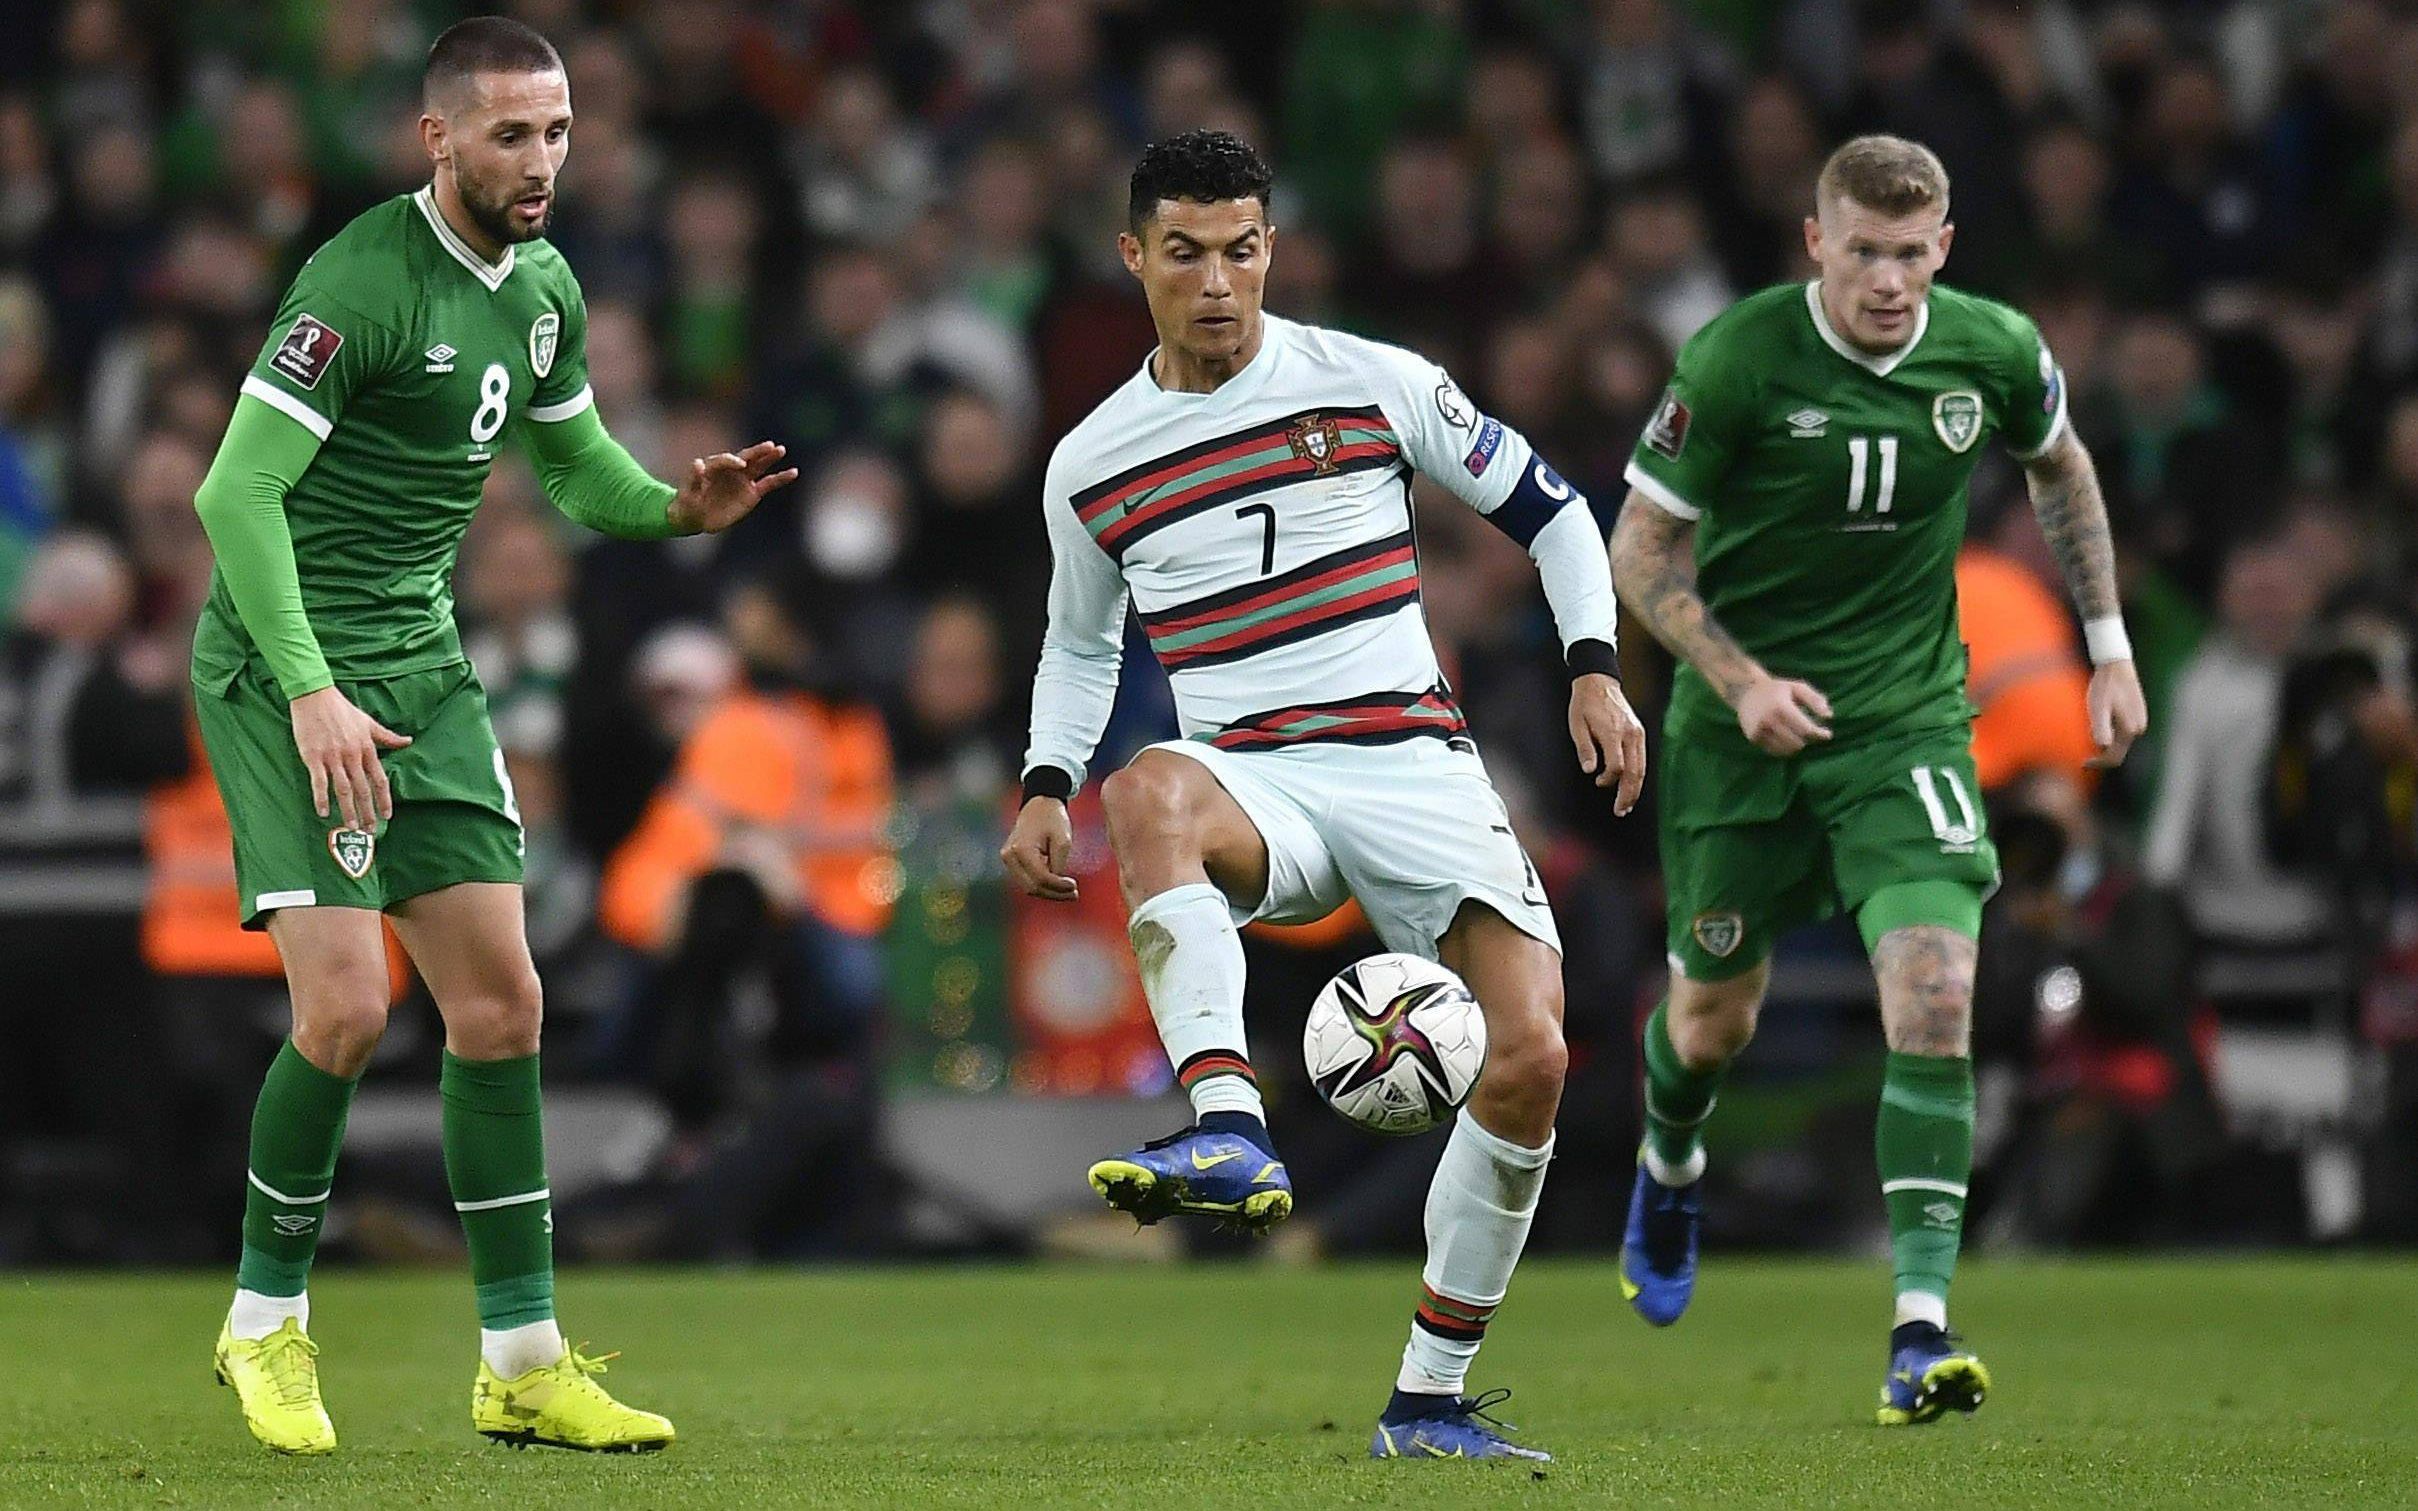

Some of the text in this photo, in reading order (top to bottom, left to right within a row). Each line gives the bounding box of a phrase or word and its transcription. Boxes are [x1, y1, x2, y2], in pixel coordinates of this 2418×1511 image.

[471, 364, 510, 443] 8
[1535, 464, 1569, 500] C
[1847, 437, 1898, 513] 11
[1235, 503, 1275, 576] 7
[1911, 766, 1976, 837] 11
